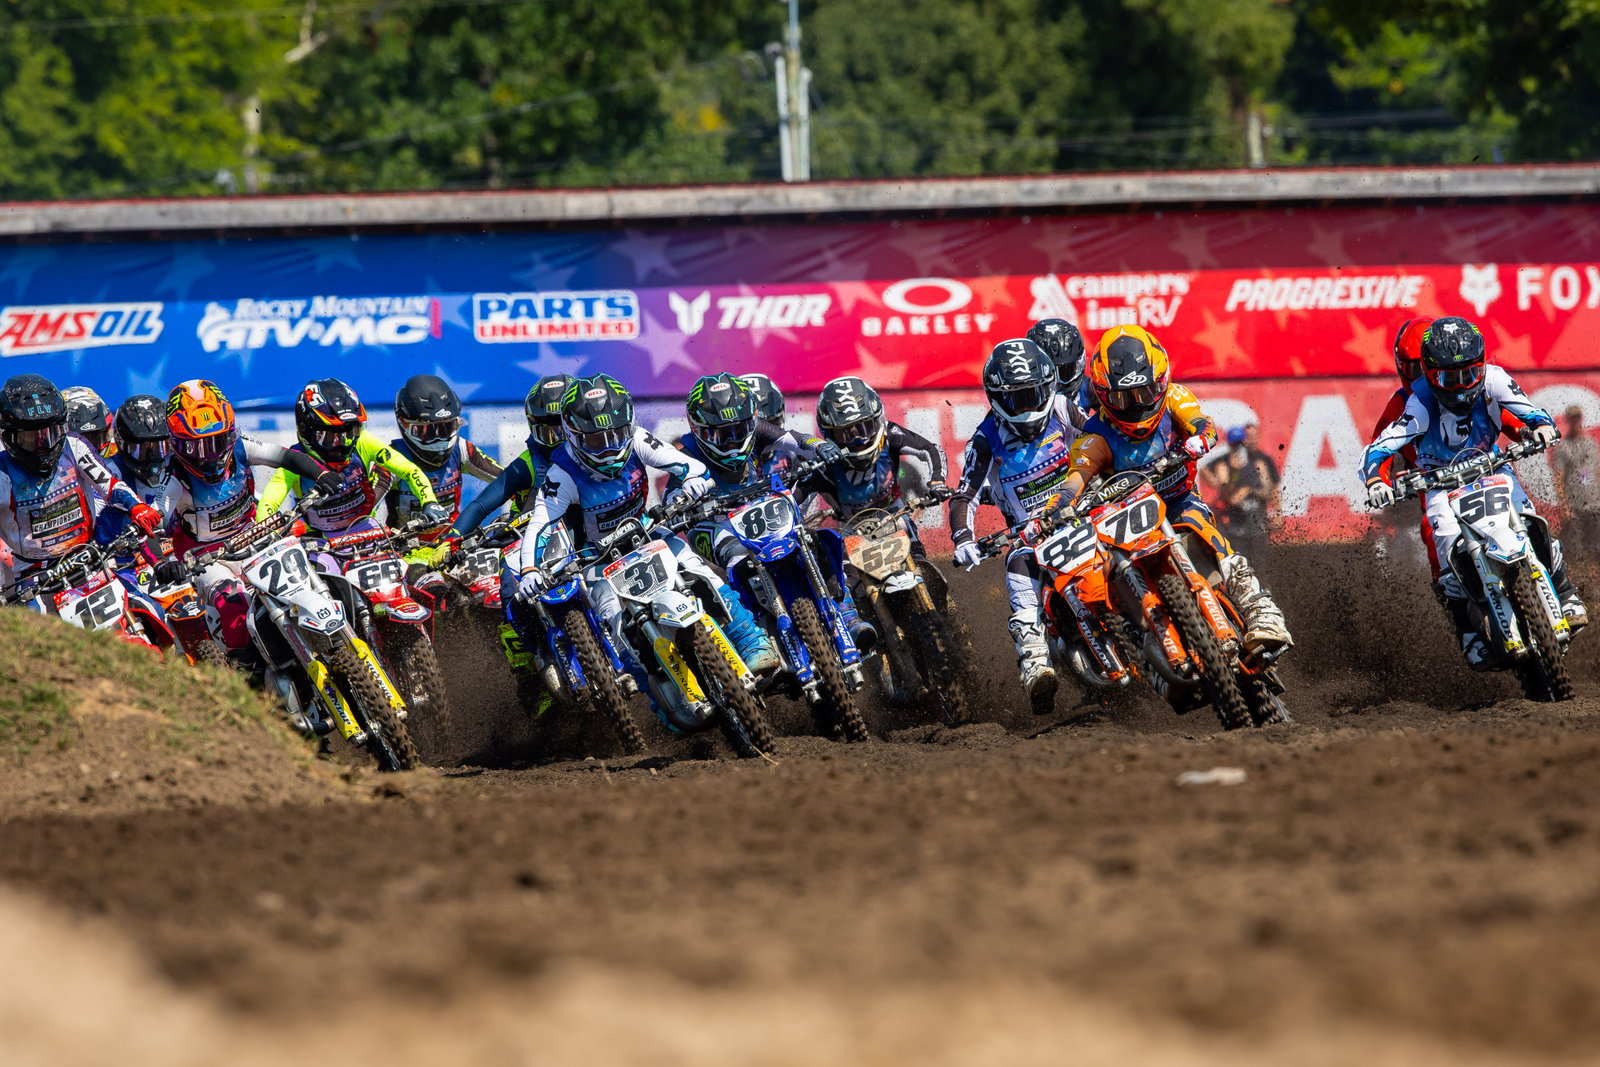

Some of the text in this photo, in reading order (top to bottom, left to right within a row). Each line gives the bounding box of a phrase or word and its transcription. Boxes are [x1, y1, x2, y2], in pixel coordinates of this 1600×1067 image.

[1065, 273, 1190, 303] campers
[1225, 276, 1426, 311] PROGRESSIVE
[479, 295, 633, 320] PARTS
[717, 294, 832, 329] THOR
[0, 310, 156, 348] AMSOIL
[479, 323, 634, 338] UNLIMITED
[861, 314, 999, 336] OAKLEY
[1004, 341, 1031, 374] FXR
[588, 389, 604, 397] BELL
[833, 380, 861, 414] FXR
[27, 404, 52, 417] FLY
[77, 453, 109, 485] FLY
[33, 510, 82, 533] CHAMPIONSHIP
[742, 500, 791, 540] 89
[1105, 499, 1159, 545] 70
[1459, 487, 1510, 524] 56
[862, 538, 904, 572] 52
[1043, 522, 1096, 568] 82
[259, 548, 309, 595] 29
[358, 562, 400, 591] 66
[460, 552, 500, 585] 35
[624, 553, 669, 596] 31
[75, 585, 122, 628] 12
[1199, 586, 1228, 631] DUNLO
[1485, 582, 1515, 639] DUNLOP
[714, 633, 736, 665] DUNLOP
[781, 629, 800, 667] DUNLOP
[1079, 621, 1111, 668] DUNLOP
[364, 660, 392, 699] DUNLOP
[673, 665, 700, 699] DUNLOP
